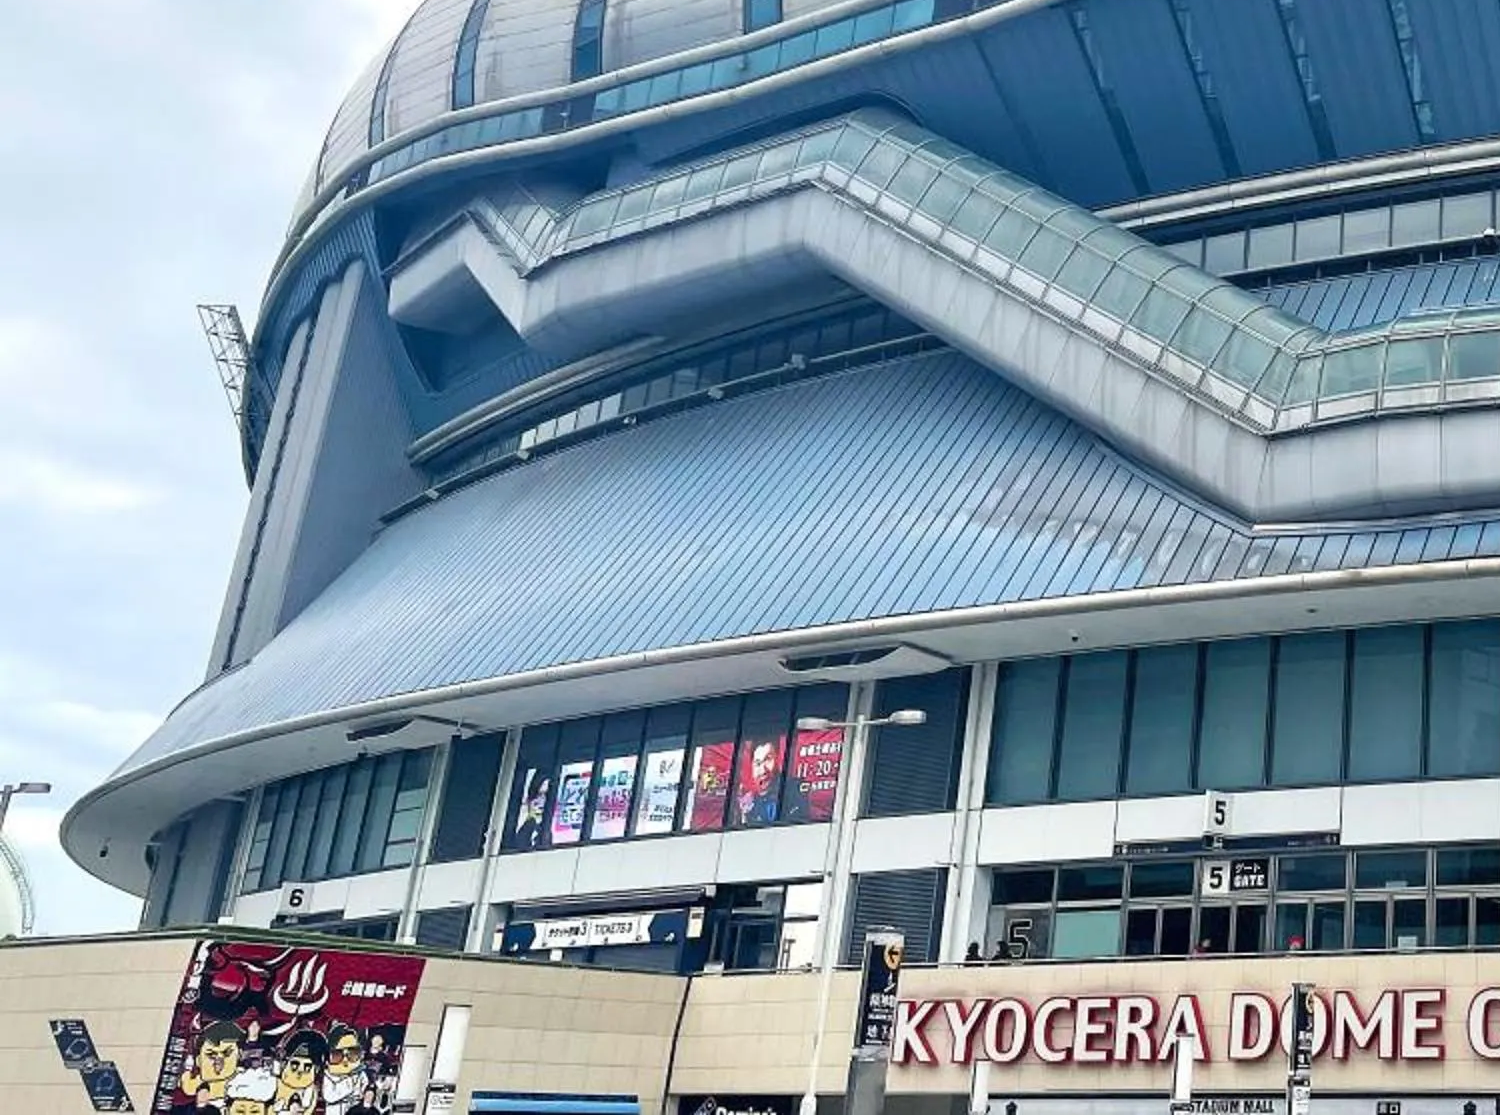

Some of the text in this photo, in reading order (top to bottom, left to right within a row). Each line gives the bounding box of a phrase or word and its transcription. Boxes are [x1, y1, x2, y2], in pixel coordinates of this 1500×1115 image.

[1214, 800, 1227, 826] 5
[1209, 866, 1223, 890] 5
[1234, 863, 1262, 874] ゲート
[1233, 874, 1265, 887] GATE
[289, 888, 304, 907] 6
[1008, 918, 1034, 960] 5
[891, 994, 1211, 1064] KYOCERA
[1228, 988, 1446, 1062] DOME
[1244, 1100, 1274, 1113] MALL
